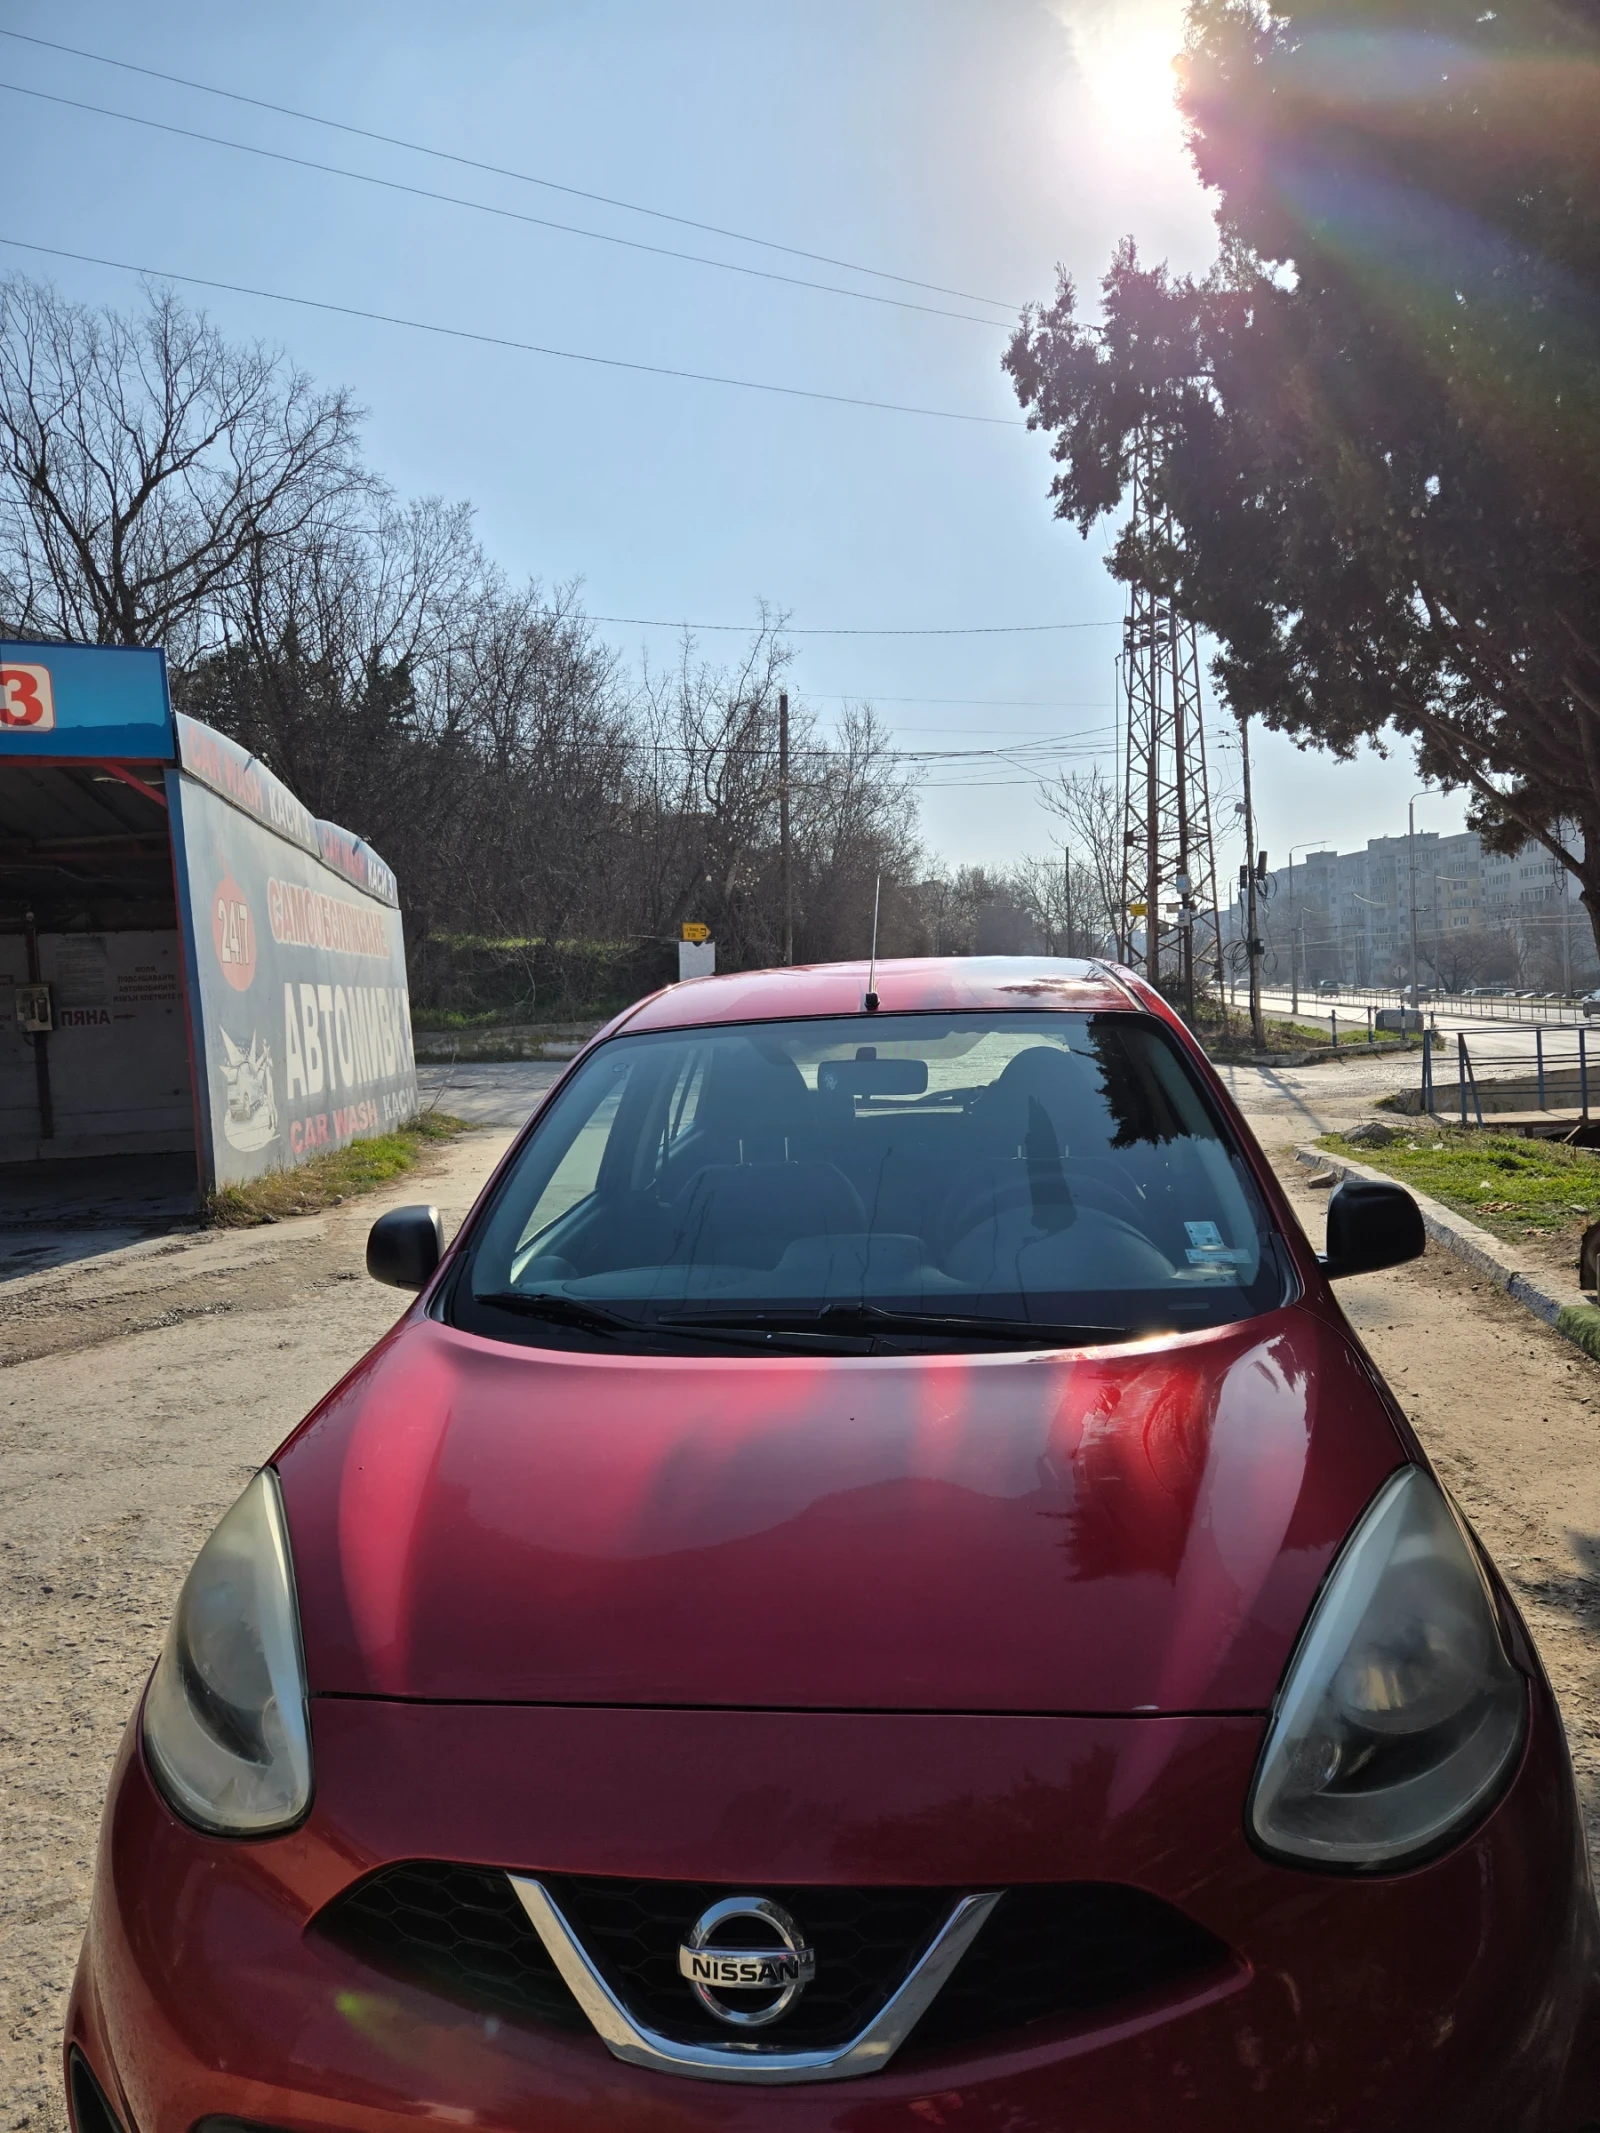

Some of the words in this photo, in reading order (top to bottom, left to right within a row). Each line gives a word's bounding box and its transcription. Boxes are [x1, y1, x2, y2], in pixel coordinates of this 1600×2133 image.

[0, 670, 43, 726] 3
[188, 724, 222, 784] CAR
[223, 750, 264, 813] WASH
[268, 784, 304, 838] КАСИ
[302, 810, 311, 844] 3
[323, 827, 342, 868] CAR
[342, 842, 365, 884] WASH
[367, 858, 387, 895] КАСИ
[388, 871, 394, 900] 3
[61, 1009, 111, 1026] ПЯНА
[284, 983, 415, 1099] АВТОМИВКА
[290, 1113, 330, 1154] CAR
[332, 1099, 379, 1140] WASH
[383, 1086, 416, 1121] КАСИ
[692, 1958, 799, 1983] NISSAN
